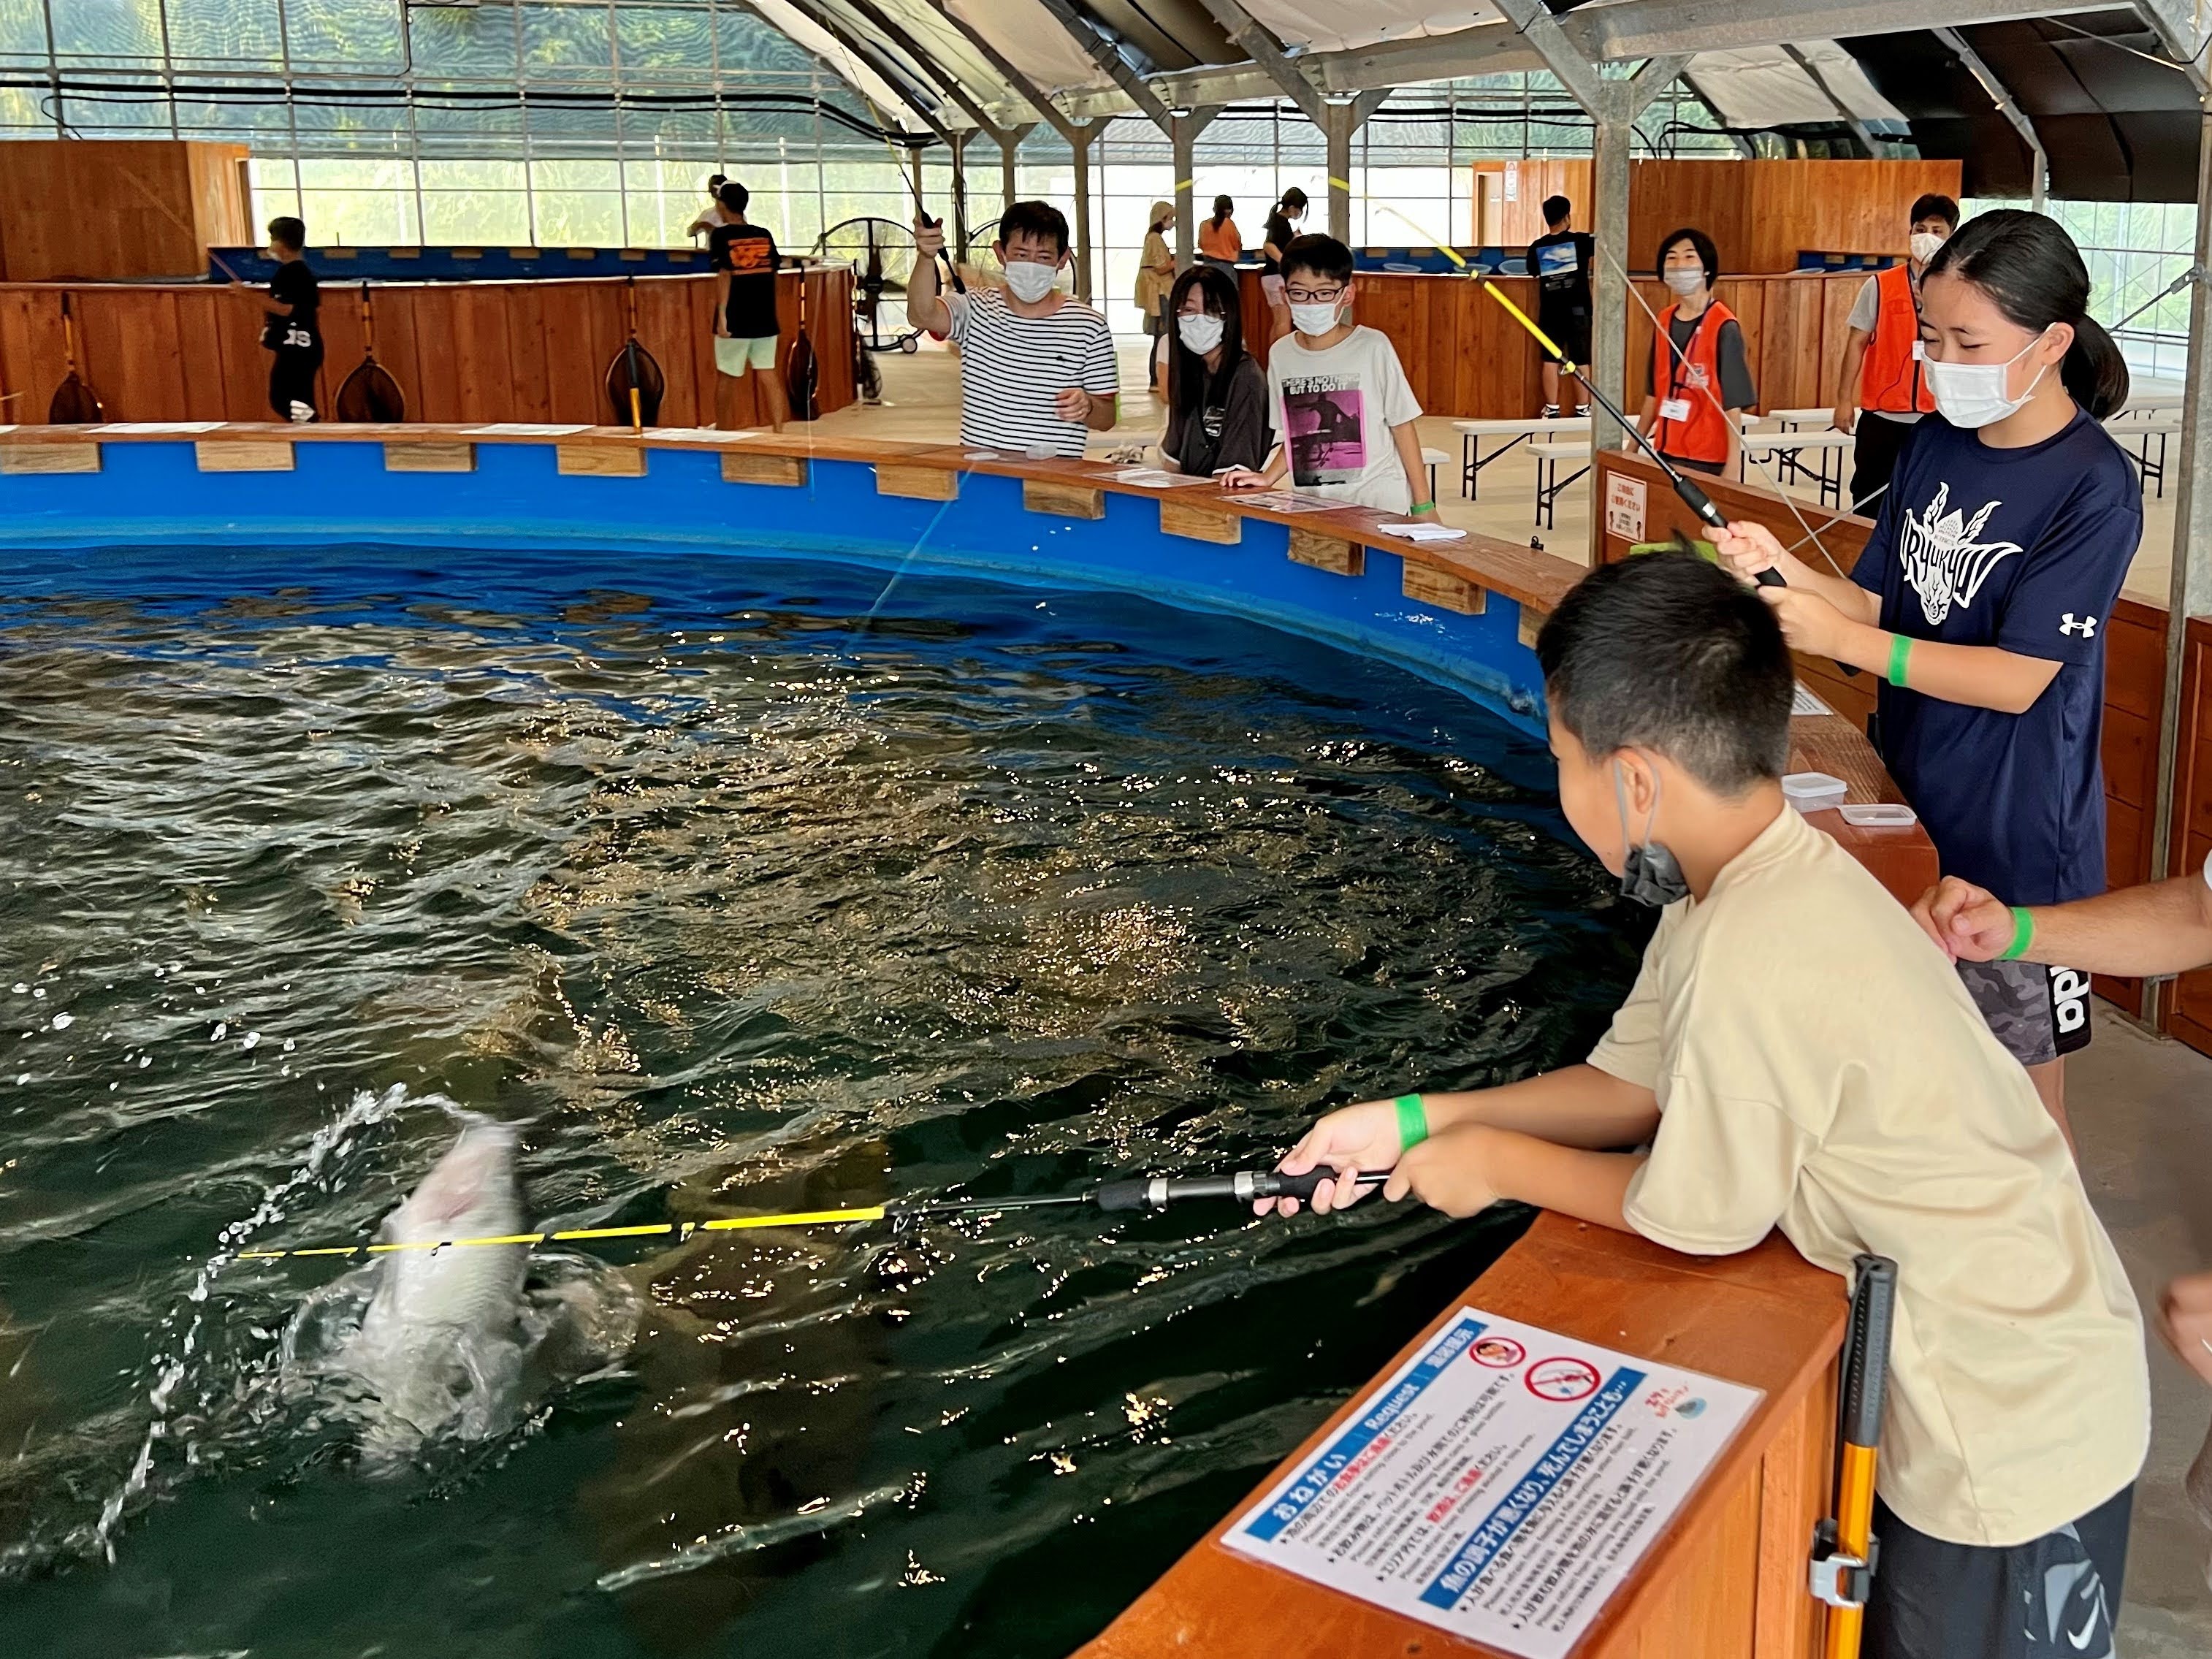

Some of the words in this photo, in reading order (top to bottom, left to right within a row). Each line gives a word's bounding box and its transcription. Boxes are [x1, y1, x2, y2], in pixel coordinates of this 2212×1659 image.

[1283, 377, 1315, 388] THERE'S
[1316, 375, 1359, 384] NOTHING
[1289, 385, 1305, 395] BUT
[1308, 384, 1320, 394] TO
[1322, 384, 1335, 392] DO
[1337, 382, 1348, 391] IT
[1273, 1452, 1348, 1522] おねがい
[1363, 1382, 1421, 1431] Request
